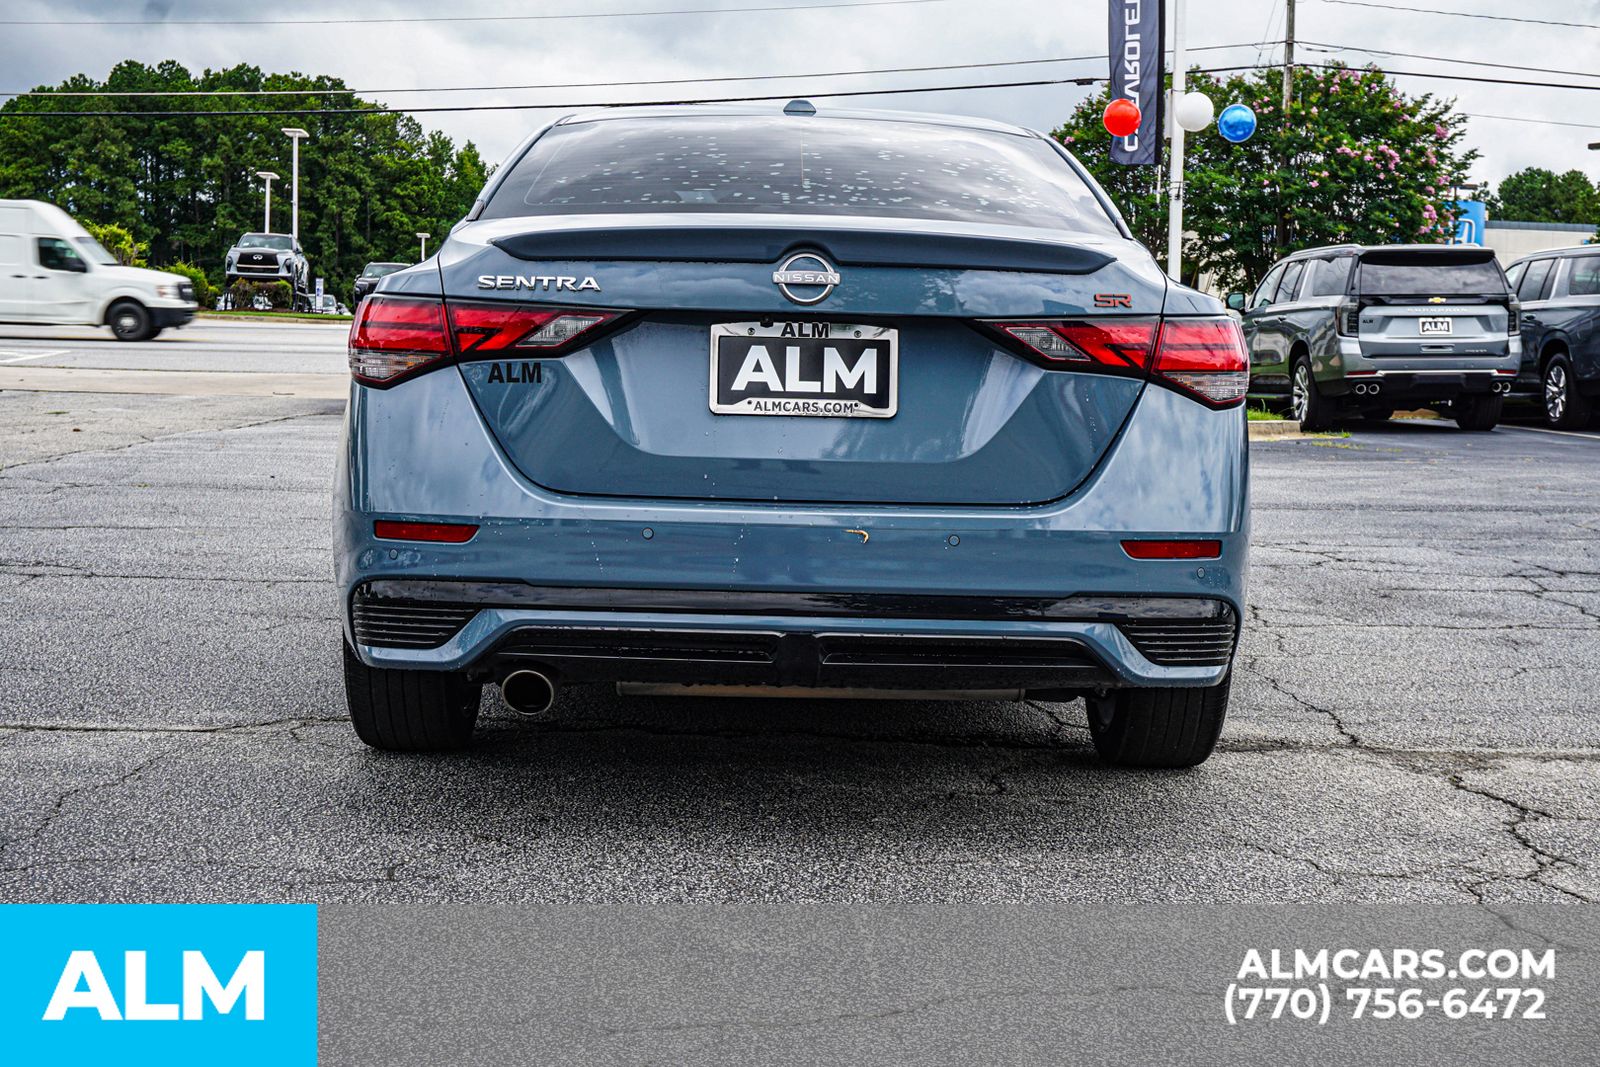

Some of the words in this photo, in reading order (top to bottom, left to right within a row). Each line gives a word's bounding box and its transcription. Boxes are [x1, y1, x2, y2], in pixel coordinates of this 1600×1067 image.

[477, 275, 601, 291] SENTRA
[773, 273, 840, 284] NISSAN
[1094, 294, 1132, 308] SR
[781, 322, 831, 338] ALM
[1423, 321, 1449, 331] ALM
[487, 362, 542, 384] ALM
[731, 345, 878, 394] ALM
[753, 401, 854, 414] ALMCARS.COM
